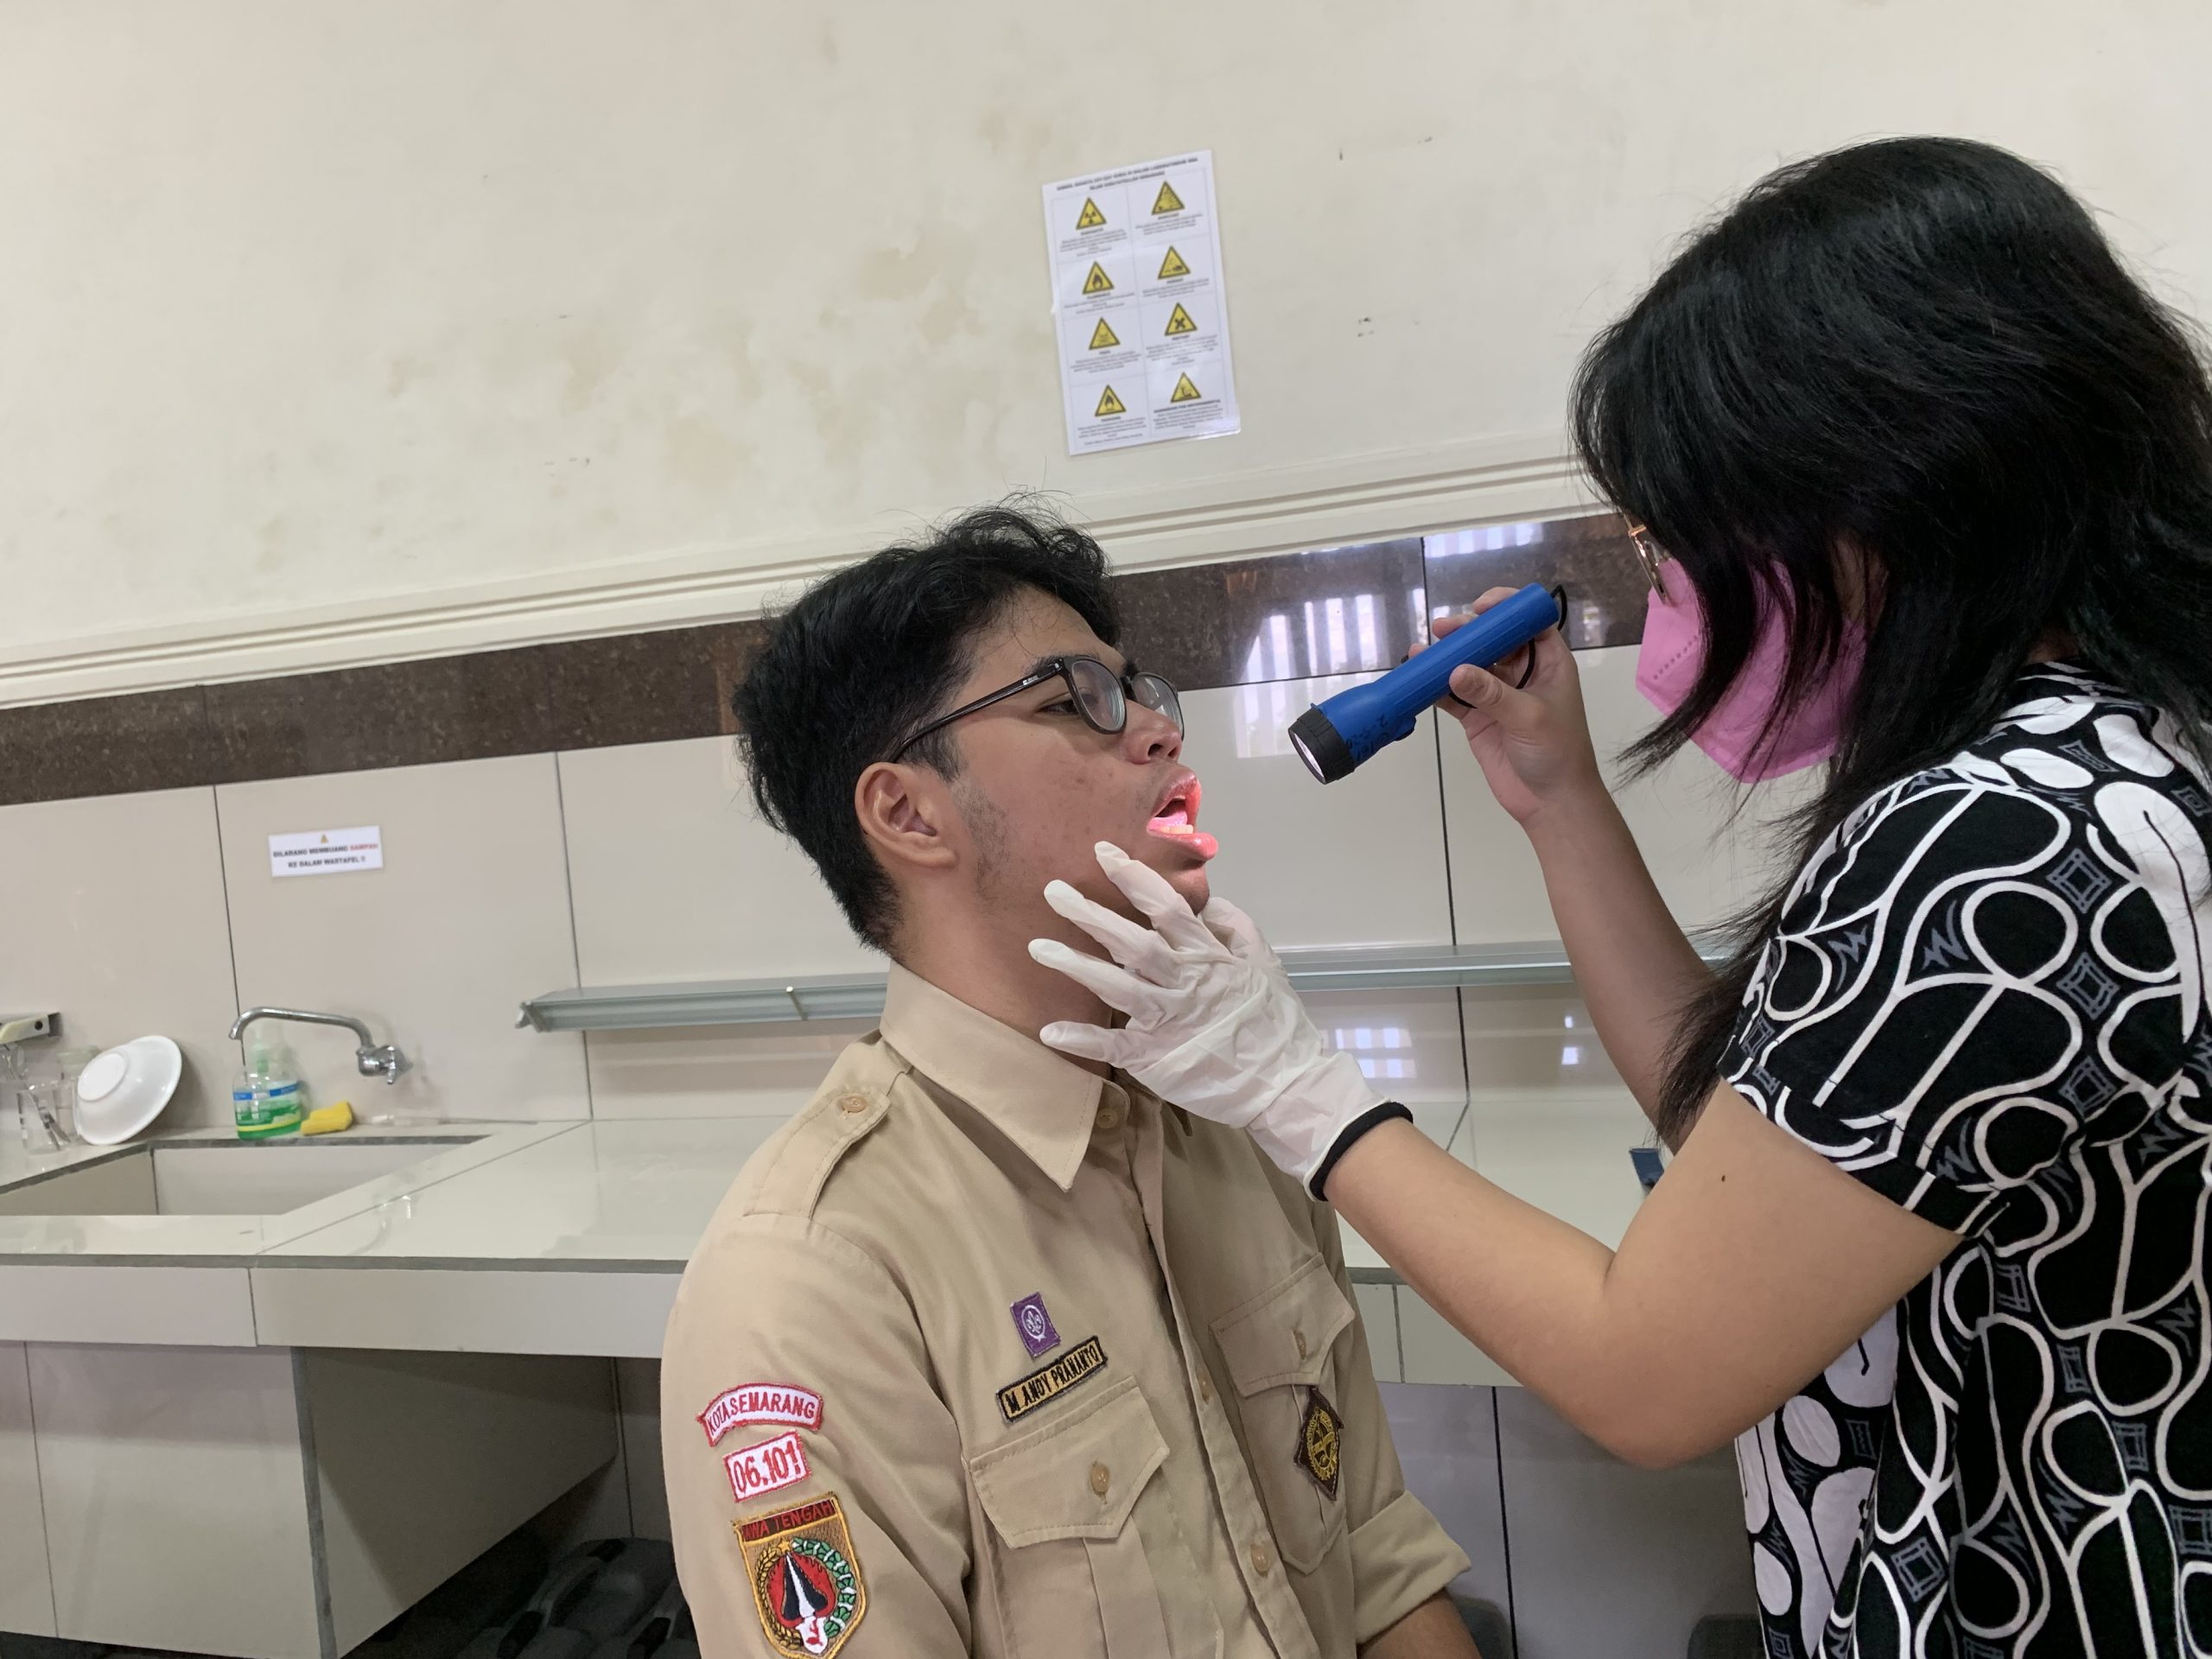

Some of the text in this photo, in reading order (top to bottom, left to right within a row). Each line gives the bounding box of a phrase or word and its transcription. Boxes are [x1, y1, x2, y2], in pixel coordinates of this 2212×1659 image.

[273, 849, 308, 858] DILARANG
[309, 844, 348, 855] MEMBUANG
[299, 859, 323, 868] DALAM
[734, 1440, 802, 1492] 06.101
[774, 1501, 833, 1530] TENGAH
